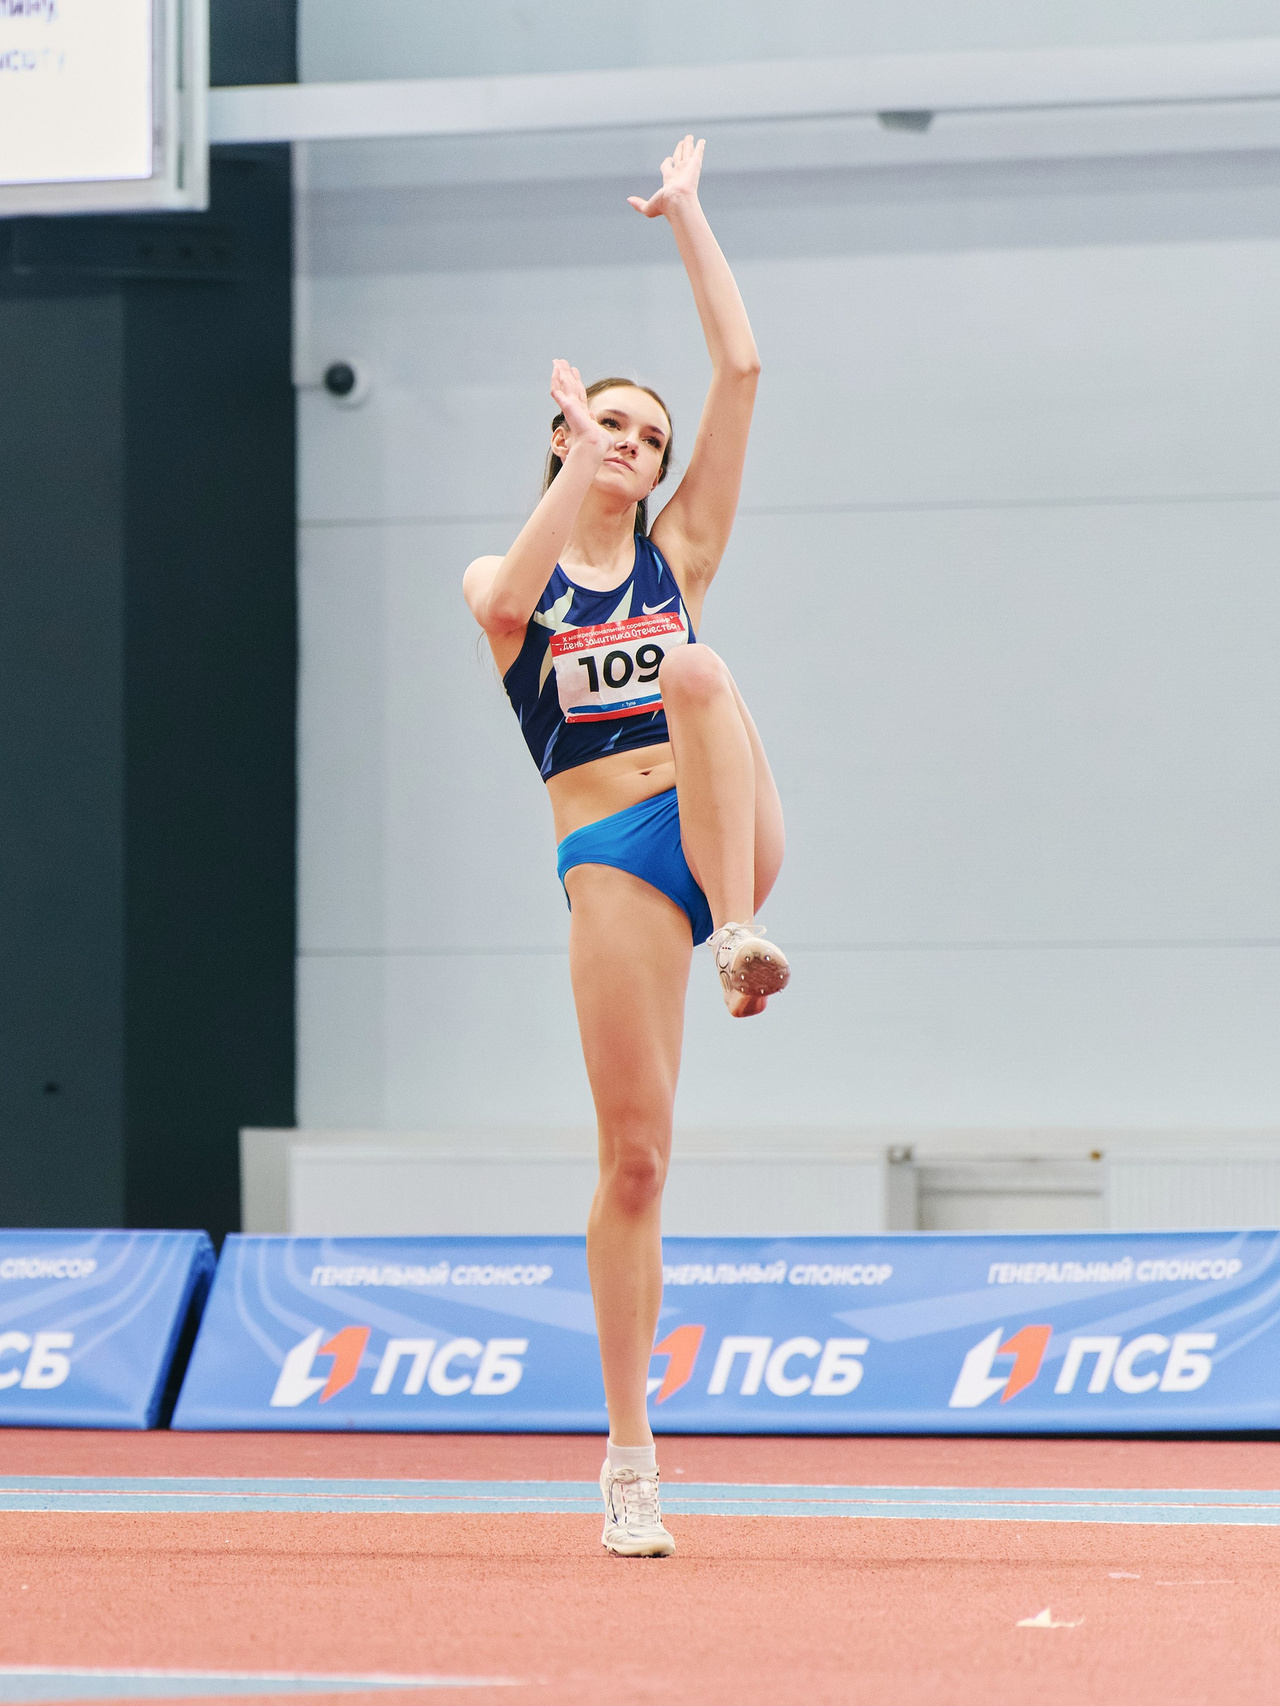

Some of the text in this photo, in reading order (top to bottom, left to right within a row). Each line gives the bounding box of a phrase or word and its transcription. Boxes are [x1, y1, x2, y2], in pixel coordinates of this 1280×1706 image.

[584, 631, 631, 647] Защитника
[578, 643, 666, 694] 109
[0, 1257, 97, 1278] СПОНСОР
[311, 1261, 553, 1286] ГЕНЕРАЛЬНЫЙ СПОНСОР
[663, 1260, 892, 1286] НЕРАЛЬНЫЙ СПОНСОР
[987, 1257, 1242, 1284] ГЕНЕРАЛЬНЫЙ СПОНСОР
[372, 1338, 528, 1395] ПСБ
[707, 1337, 869, 1396] ПСБ
[1055, 1333, 1217, 1393] ПСБ
